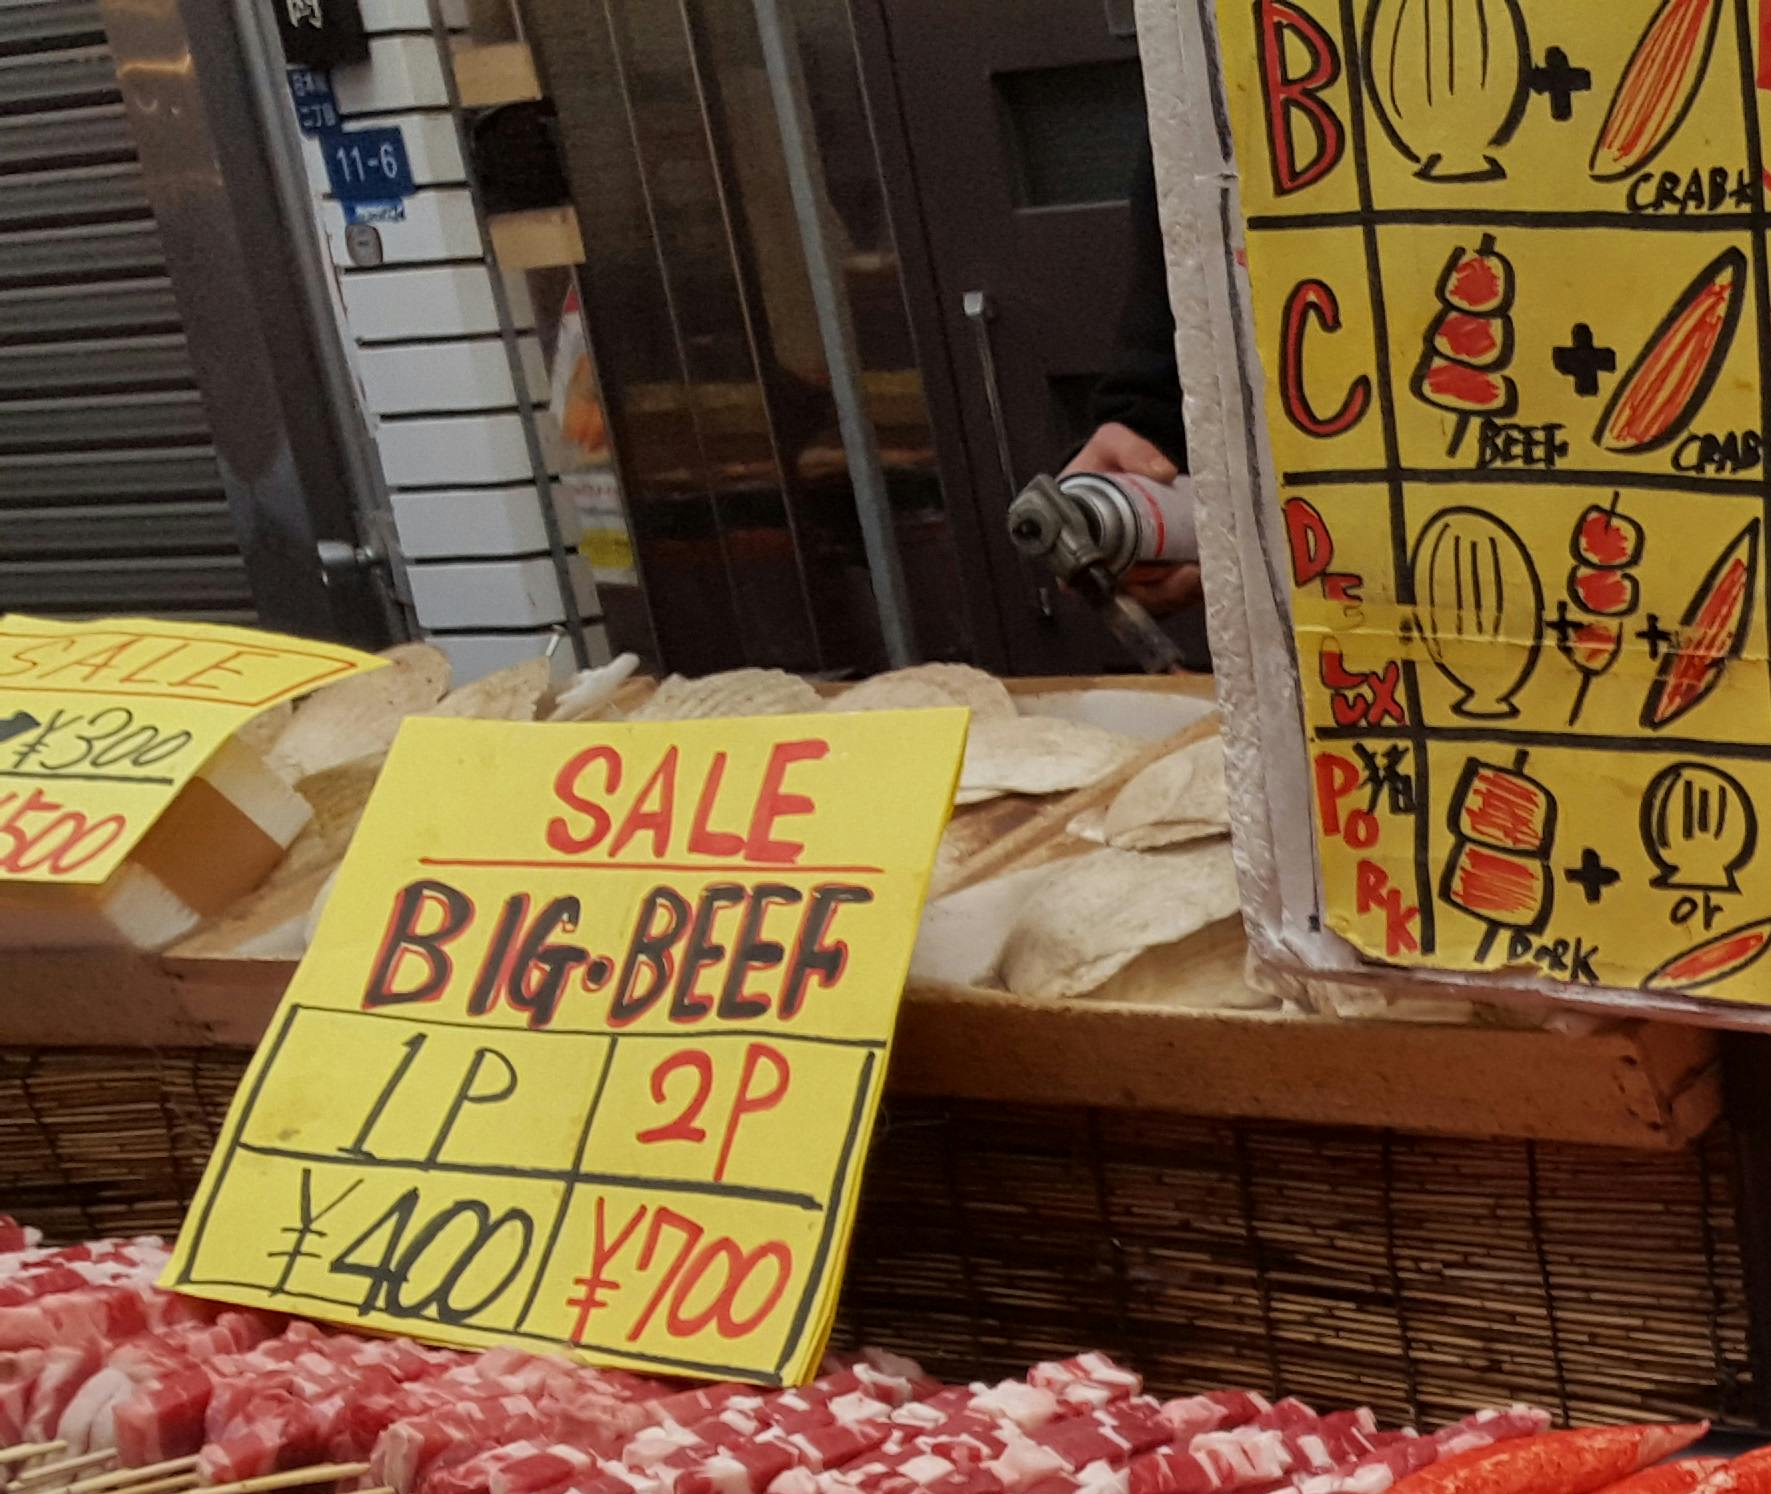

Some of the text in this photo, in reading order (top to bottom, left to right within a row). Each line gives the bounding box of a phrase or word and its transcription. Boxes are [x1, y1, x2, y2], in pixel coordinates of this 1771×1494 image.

[1254, 0, 1345, 195] B
[336, 141, 398, 182] 11-6
[1277, 277, 1372, 439] C
[1477, 416, 1569, 470] BEEF
[0, 634, 280, 690] SALE
[12, 706, 192, 771] ¥300
[546, 738, 830, 865] SALE
[0, 788, 126, 874] 500
[635, 1041, 792, 1182] 2P
[267, 1168, 793, 1347] ¥400 ¥700
